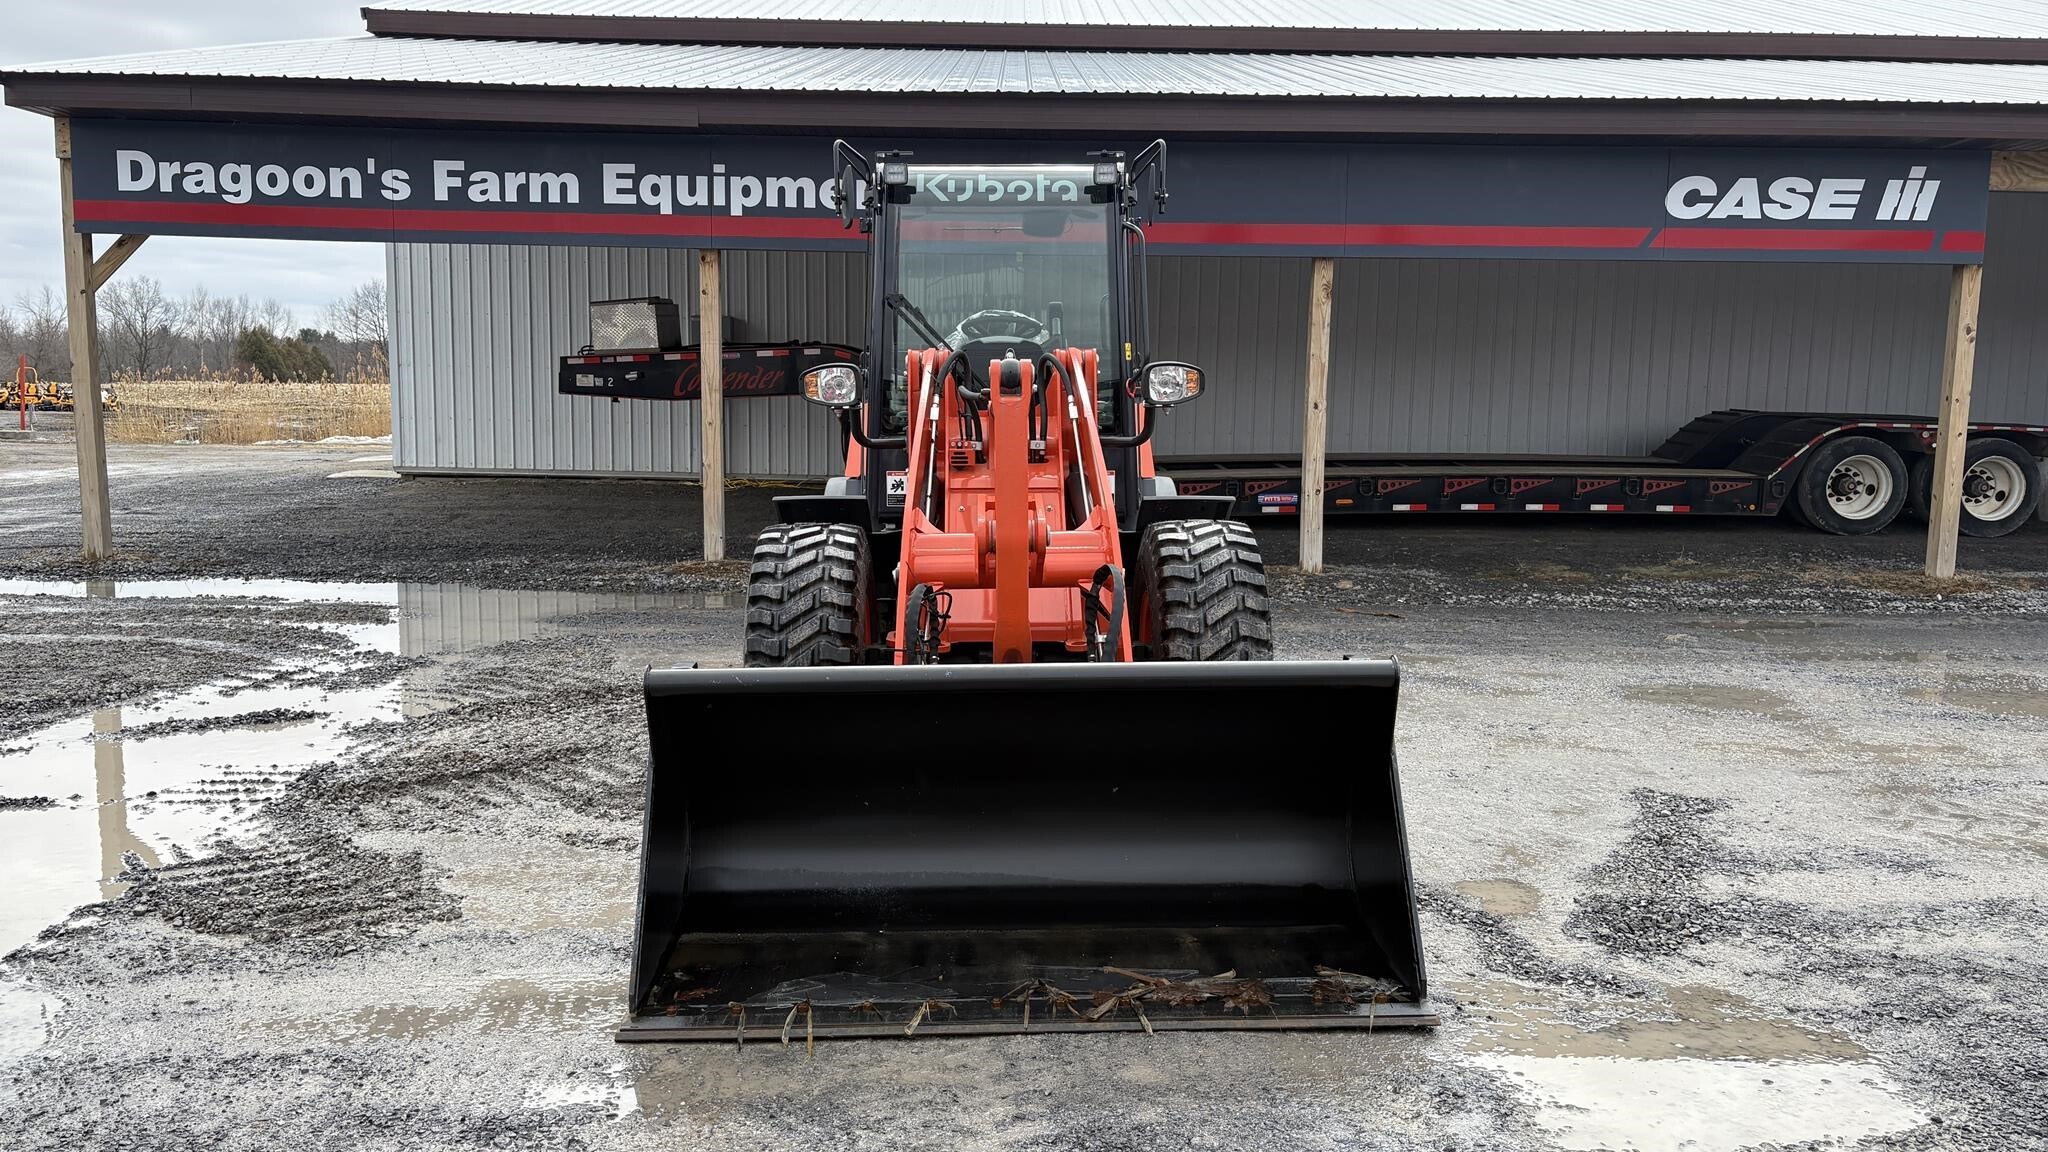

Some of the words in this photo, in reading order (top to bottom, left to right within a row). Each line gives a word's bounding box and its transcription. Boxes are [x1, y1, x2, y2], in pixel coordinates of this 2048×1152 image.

[115, 150, 412, 204] Dragoon's
[433, 159, 580, 204] Farm
[916, 173, 1078, 202] Kubota
[1664, 175, 1866, 220] CASE
[607, 377, 614, 387] 2
